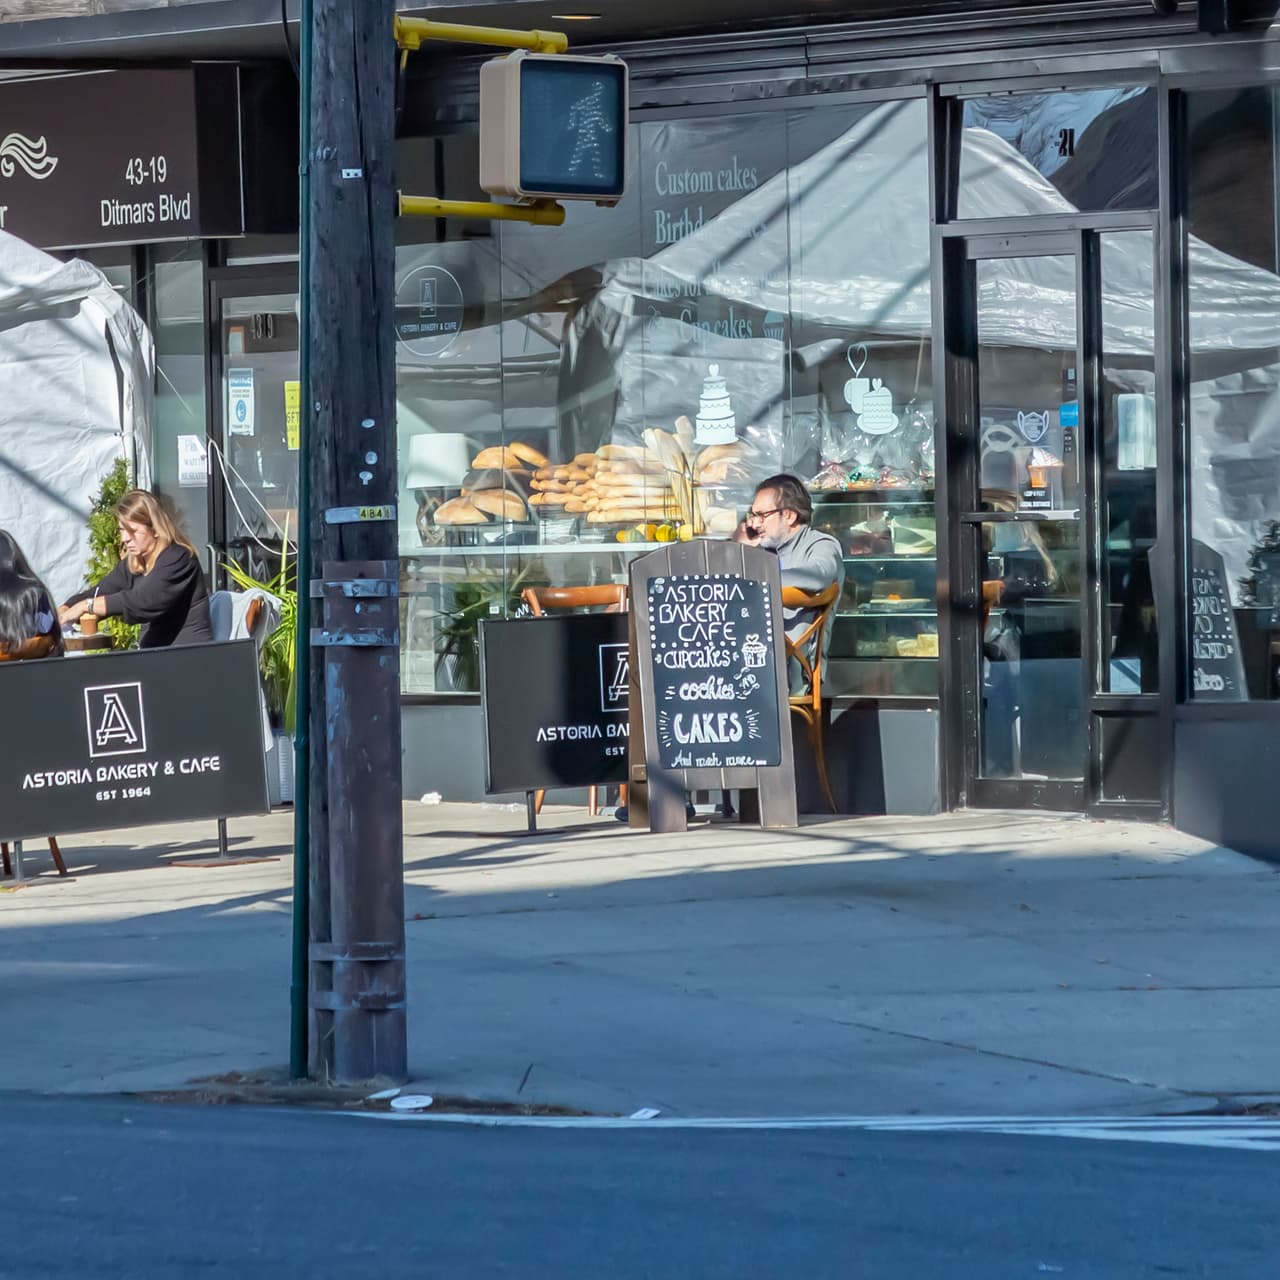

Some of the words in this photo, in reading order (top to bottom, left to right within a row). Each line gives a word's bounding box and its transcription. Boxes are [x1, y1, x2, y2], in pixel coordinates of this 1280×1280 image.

[125, 155, 167, 185] 43-19
[655, 160, 714, 196] Custom
[717, 156, 758, 191] cakes
[100, 197, 156, 227] Ditmars
[159, 193, 191, 222] Blvd
[714, 305, 753, 339] cakes
[665, 584, 744, 603] ASTORIA
[659, 603, 728, 623] BAKERY
[741, 607, 750, 618] &
[678, 622, 737, 641] CAFE
[679, 675, 735, 700] cookies
[536, 725, 602, 742] ASTORIA
[606, 723, 629, 737] BA
[673, 712, 743, 744] CAKES
[605, 747, 625, 757] EST
[22, 768, 93, 790] ASTORIA
[96, 761, 159, 782] BAKERY
[164, 761, 175, 776] &
[179, 756, 221, 775] CAFE
[96, 789, 120, 802] EST
[122, 786, 151, 800] 1964
